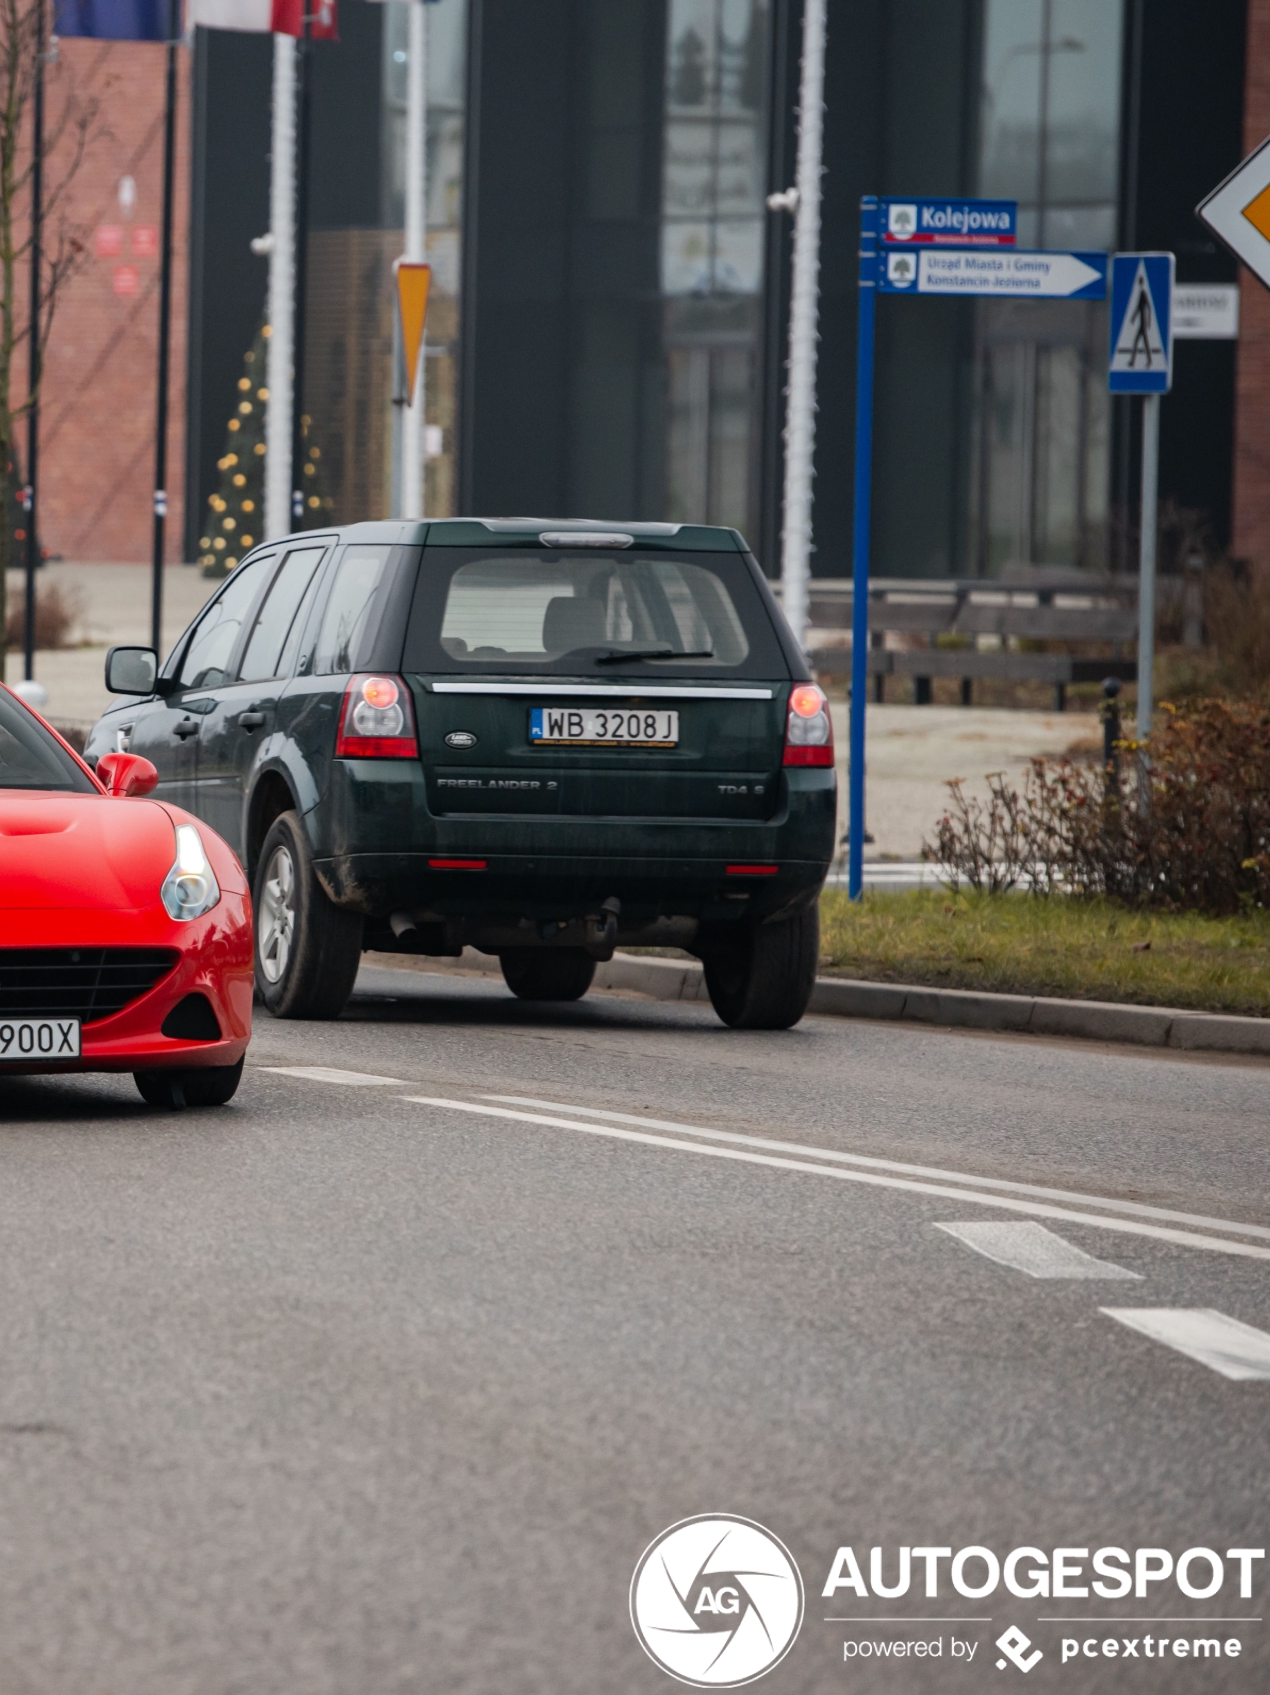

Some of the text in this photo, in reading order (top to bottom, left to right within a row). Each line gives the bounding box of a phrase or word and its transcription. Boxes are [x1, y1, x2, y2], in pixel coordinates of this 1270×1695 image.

[922, 206, 1010, 234] Kolejowa
[927, 257, 961, 271] Urząd
[965, 258, 1004, 271] Miasta
[1014, 259, 1051, 276] Gminy
[548, 712, 584, 737] WB
[595, 713, 672, 739] 3208J
[437, 779, 558, 790] FREELANDER 2
[718, 785, 764, 795] TD4 S
